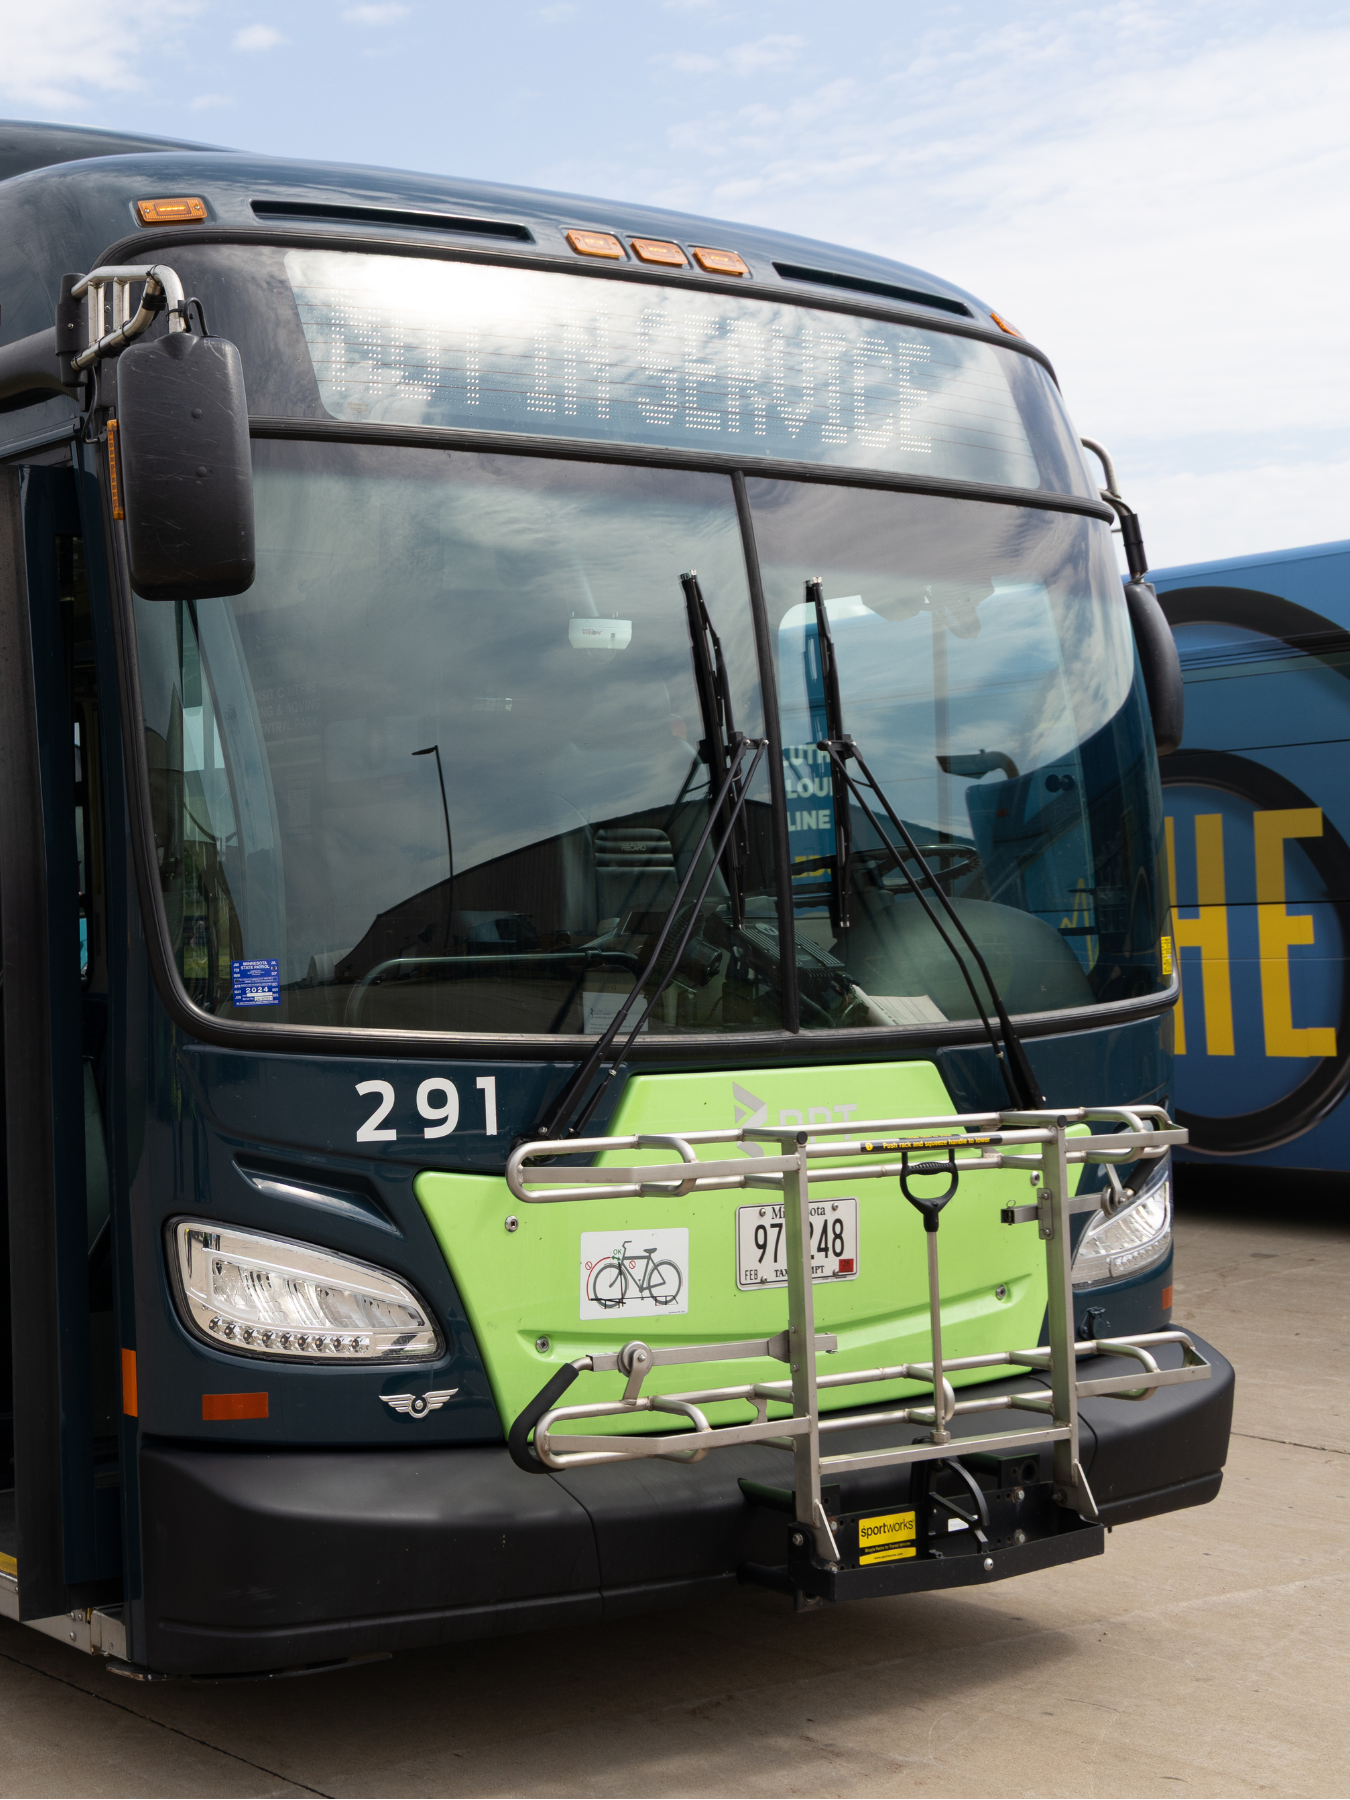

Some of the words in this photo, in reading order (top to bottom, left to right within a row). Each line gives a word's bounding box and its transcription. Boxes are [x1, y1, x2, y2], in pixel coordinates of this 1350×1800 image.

[787, 776, 834, 799] LOU
[621, 844, 647, 852] RECARO
[355, 1075, 499, 1143] 291
[882, 1141, 898, 1150] Push
[912, 1140, 924, 1148] and
[925, 1139, 948, 1148] squeeze
[948, 1138, 967, 1146] handle
[974, 1136, 991, 1144] lower
[771, 1205, 826, 1220] Miota
[754, 1217, 845, 1264] 9748
[744, 1269, 759, 1281] FEB
[861, 1518, 914, 1539] sportworks
